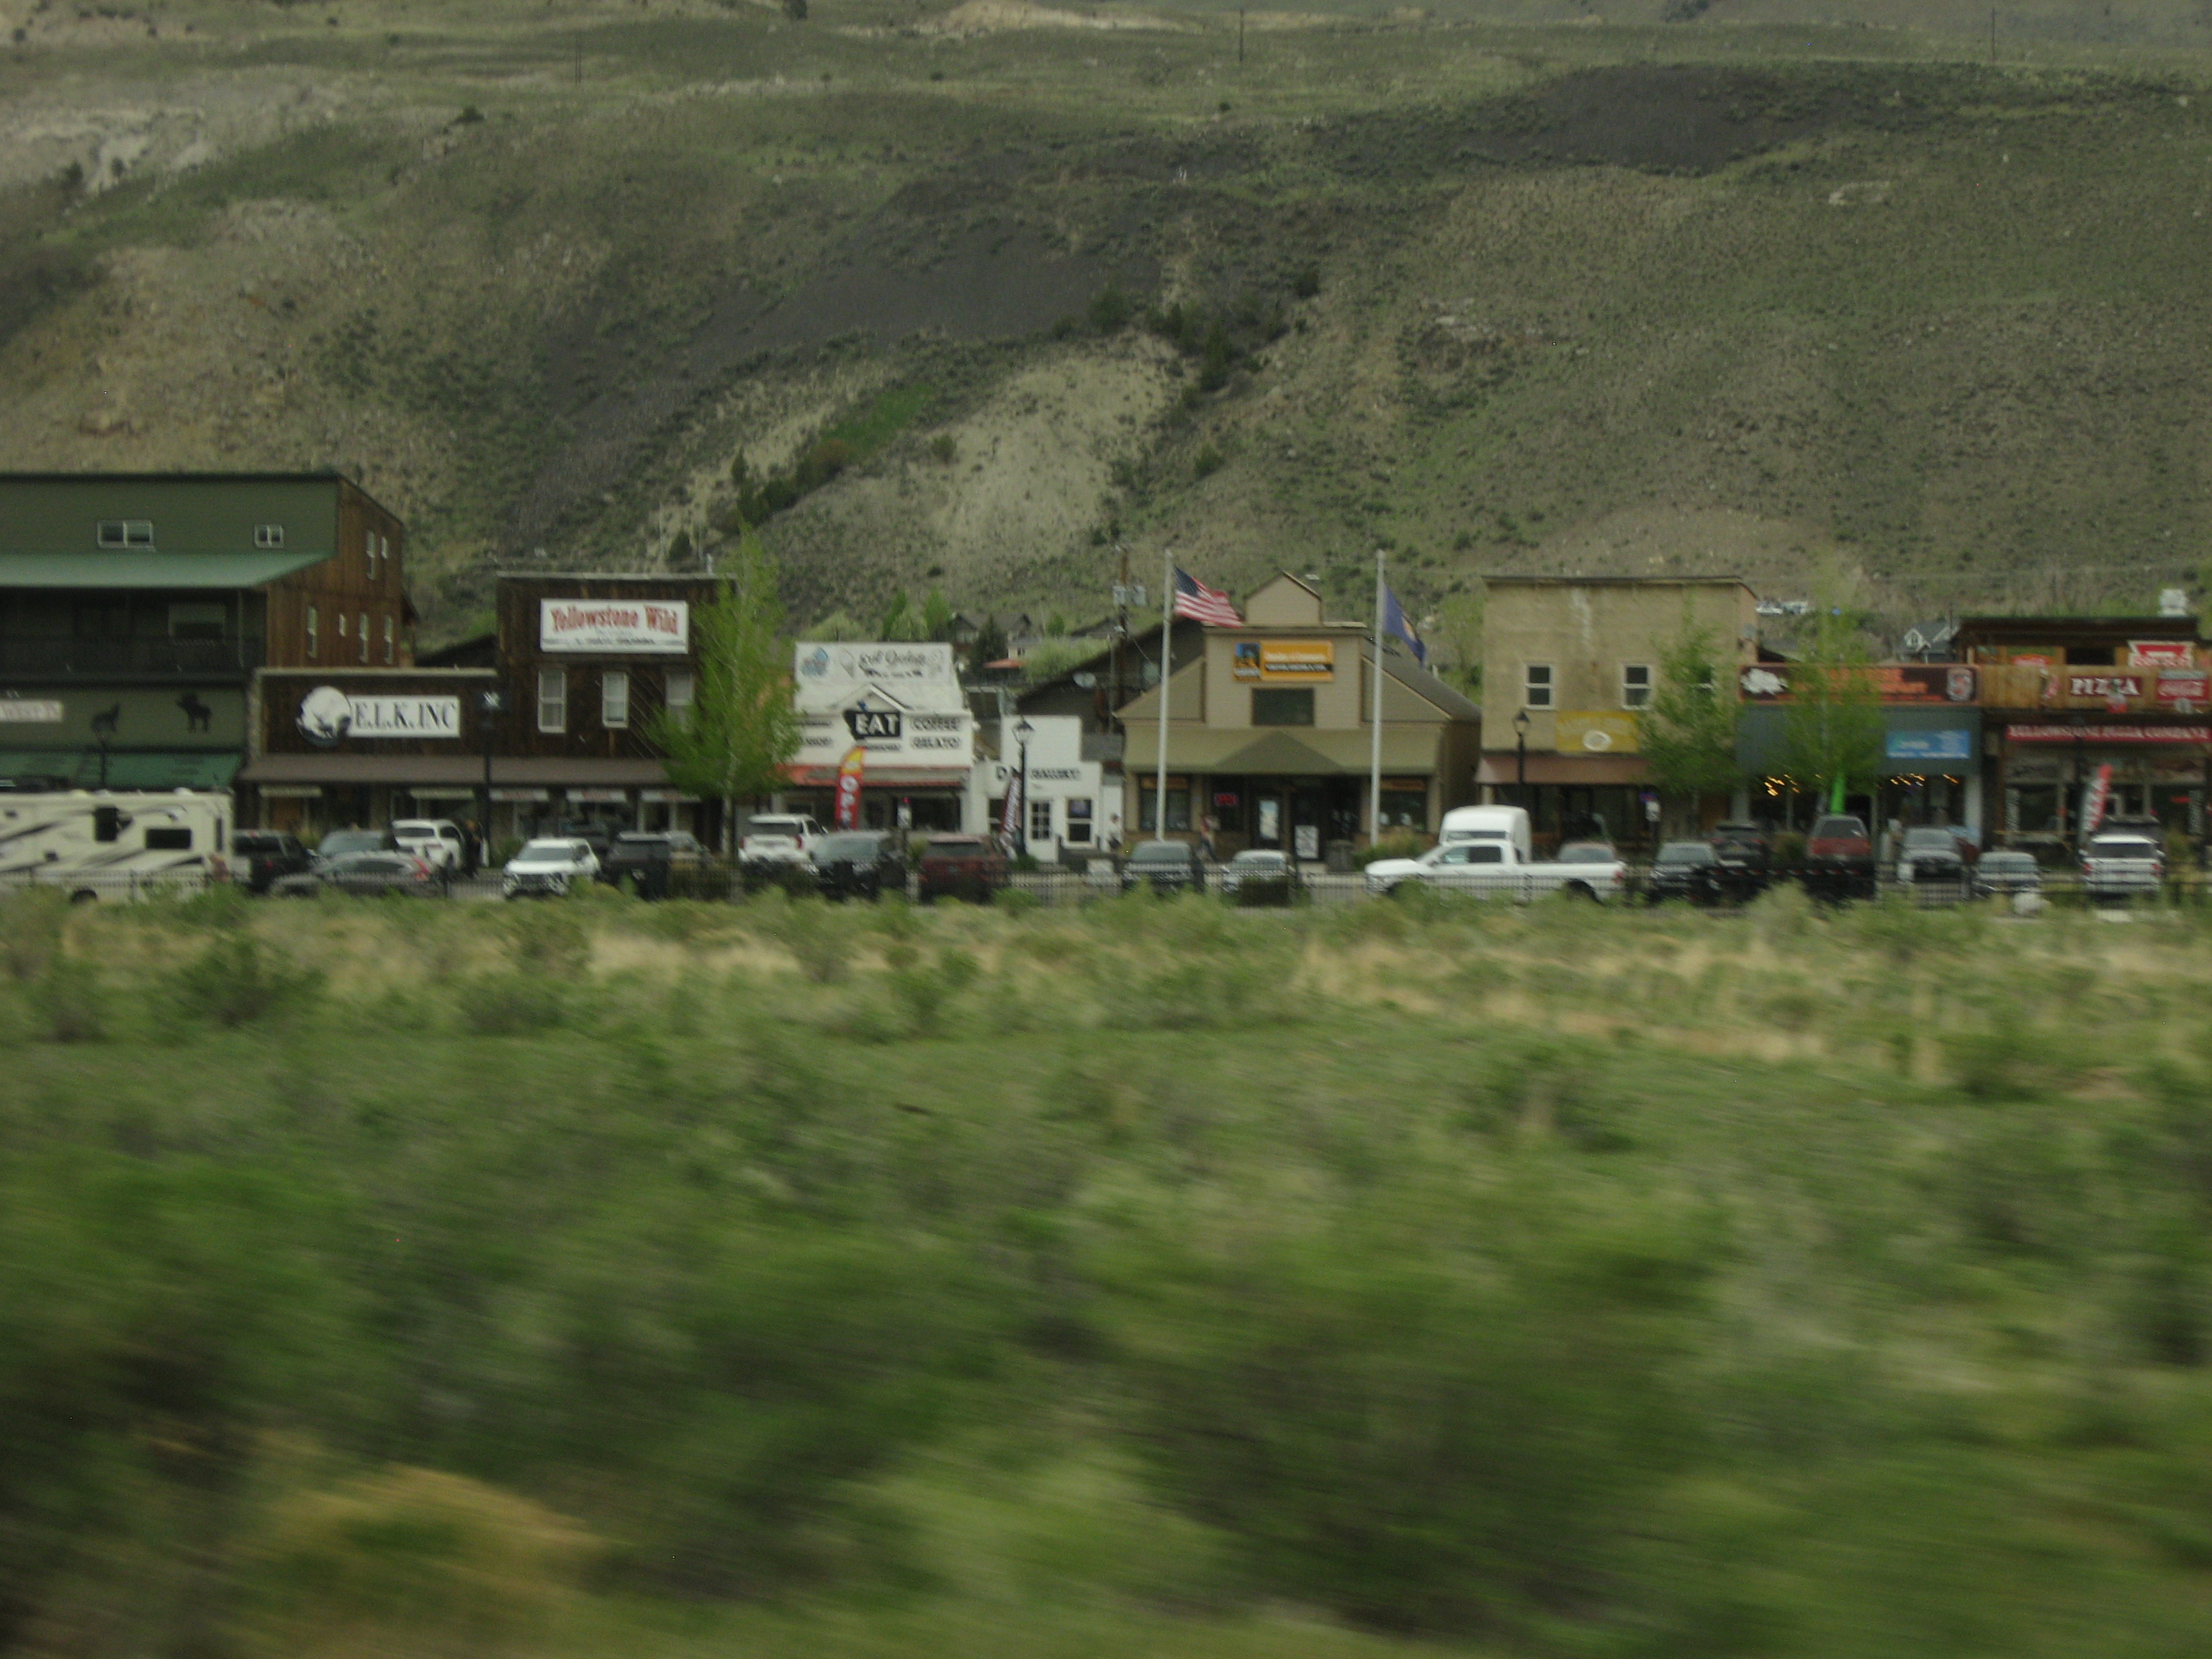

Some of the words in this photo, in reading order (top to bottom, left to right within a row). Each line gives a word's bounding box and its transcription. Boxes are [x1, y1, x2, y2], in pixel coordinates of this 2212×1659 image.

[550, 605, 639, 631] Yellowstone
[644, 605, 678, 634] Wild
[855, 714, 899, 735] EAT
